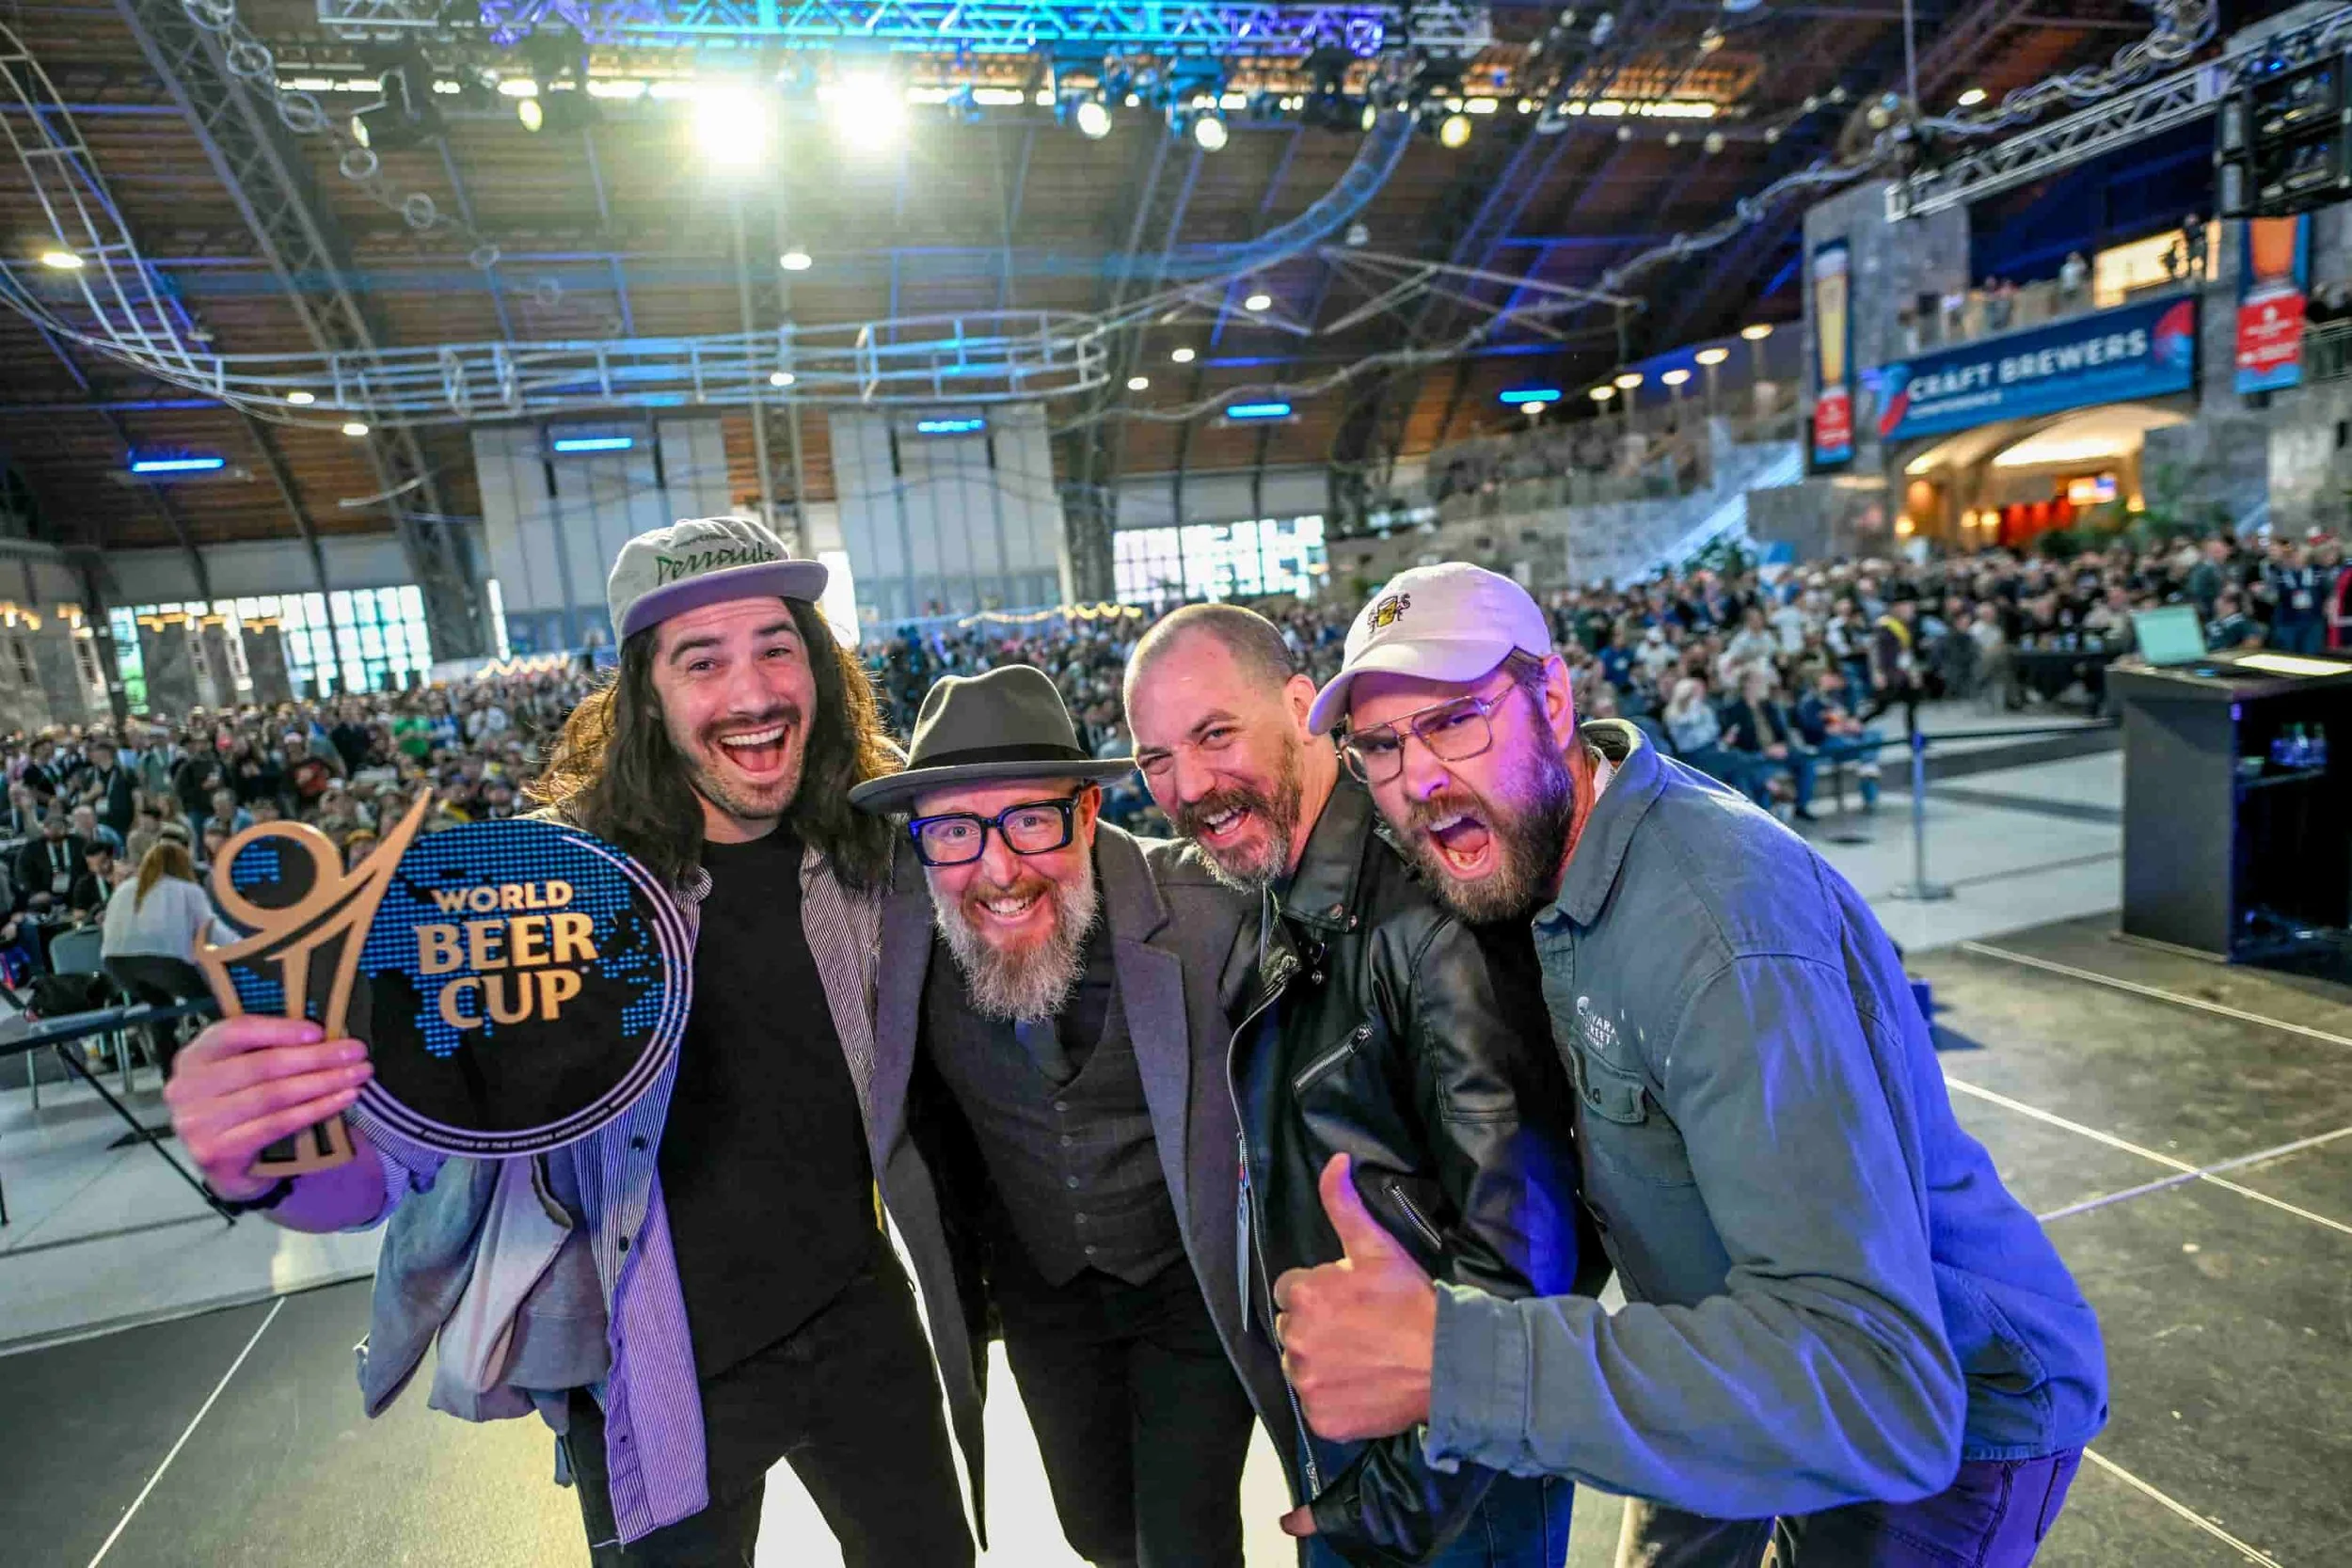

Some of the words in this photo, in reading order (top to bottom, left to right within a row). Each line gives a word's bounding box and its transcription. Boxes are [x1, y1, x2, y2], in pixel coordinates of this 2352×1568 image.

[1907, 362, 1994, 402] CRAFT
[1998, 328, 2148, 383] BREWERS
[430, 879, 574, 914] WORLD
[412, 912, 599, 974] BEER
[438, 969, 582, 1029] CUP
